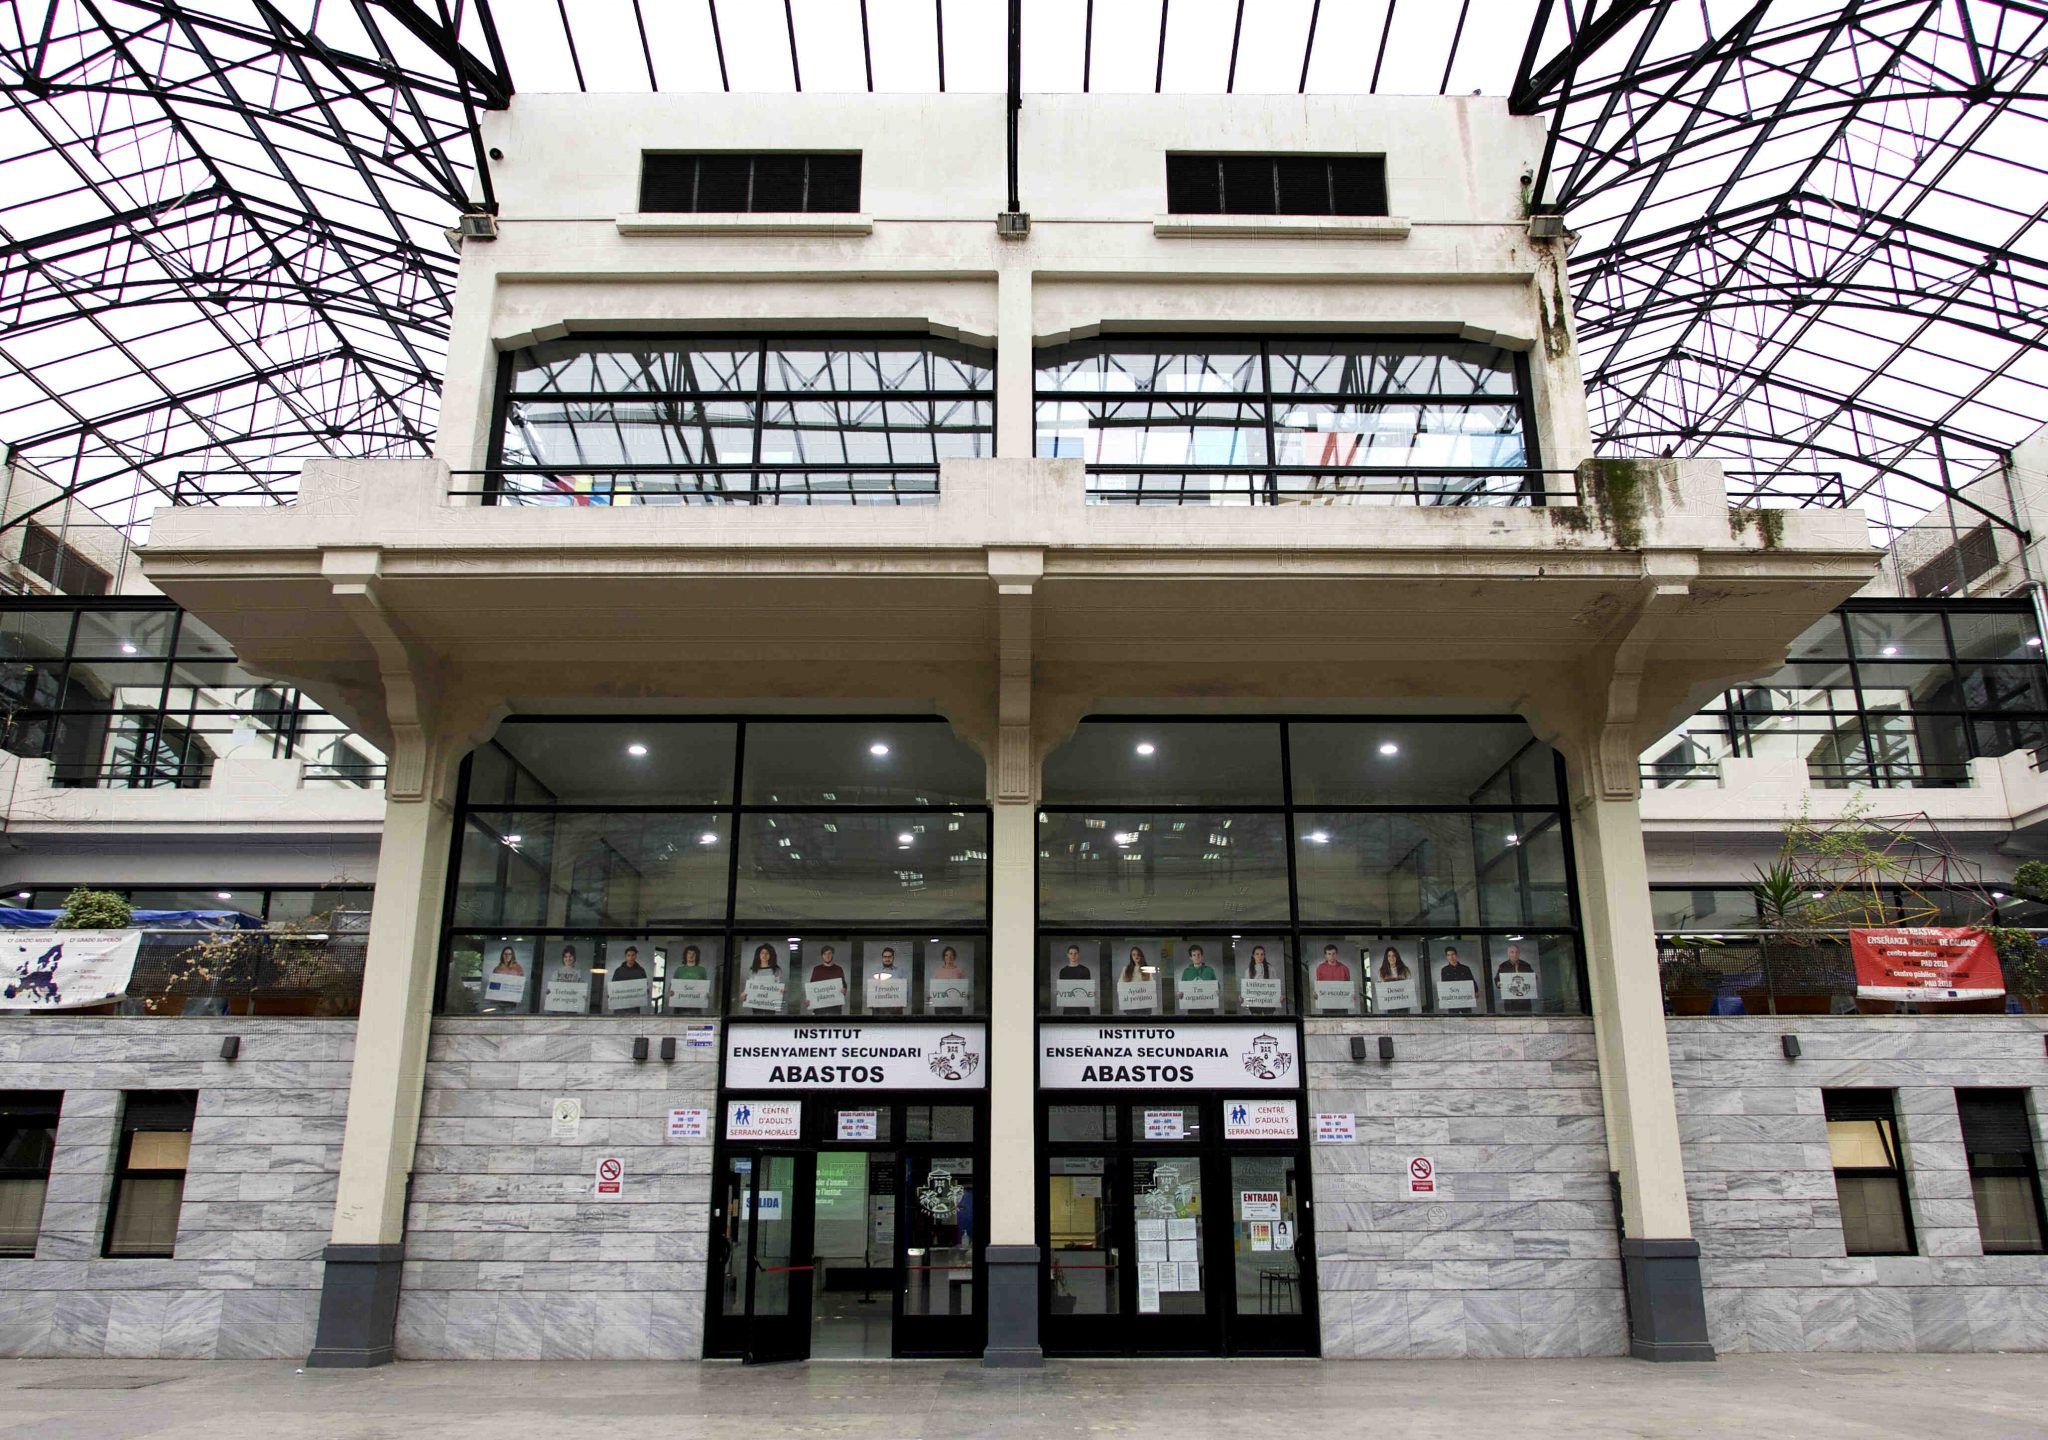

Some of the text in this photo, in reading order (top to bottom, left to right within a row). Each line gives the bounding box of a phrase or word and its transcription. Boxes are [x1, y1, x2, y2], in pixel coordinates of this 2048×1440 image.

[1867, 936, 1908, 945] ENSEÑANZA
[1939, 938, 1948, 946] DE
[1908, 950, 1937, 958] educativo
[794, 1029, 862, 1039] INSTITUT
[1099, 1029, 1175, 1039] INSTITUTO
[733, 1047, 921, 1058] ENSENYAMENT SECUNDARI
[1046, 1045, 1229, 1058] ENSEÑANZA SECUNDARIA
[769, 1066, 885, 1083] ABASTOS
[1081, 1065, 1194, 1082] ABASTOS
[758, 1117, 793, 1125] D'ADULTS
[746, 1197, 779, 1208] SLIDA
[1243, 1193, 1278, 1202] ENTRADA
